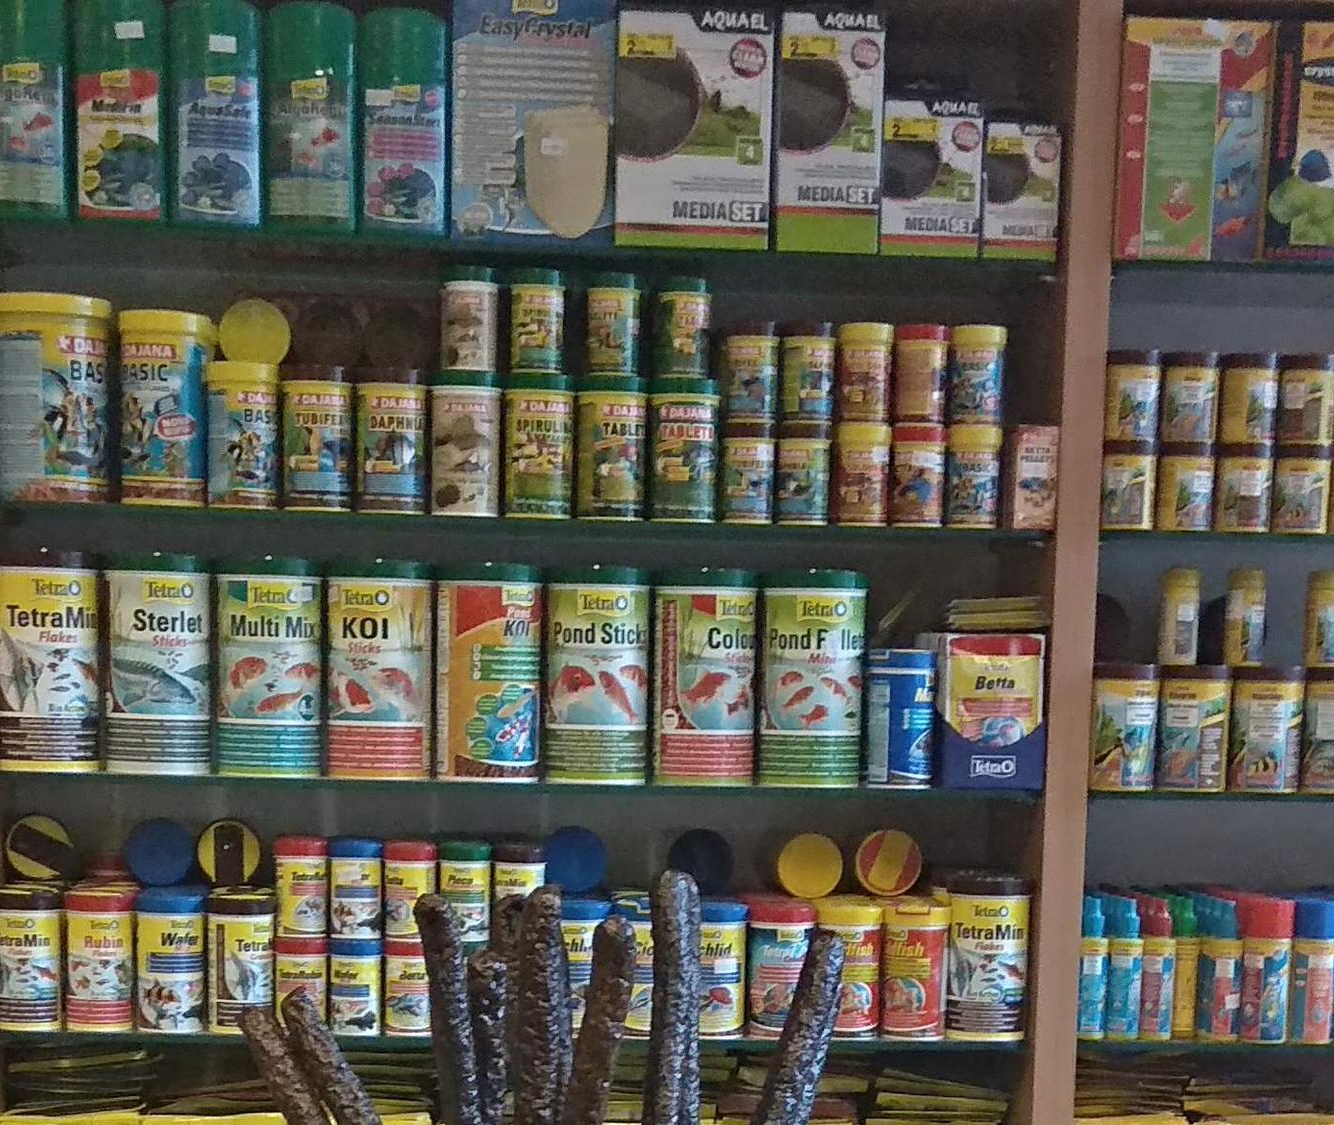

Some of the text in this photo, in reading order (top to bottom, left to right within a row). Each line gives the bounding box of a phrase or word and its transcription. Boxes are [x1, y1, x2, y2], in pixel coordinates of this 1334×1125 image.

[700, 12, 768, 30] AQUAEL
[824, 13, 880, 30] AQUAEL
[343, 589, 375, 605] Tetra
[579, 592, 613, 610] Tetra
[802, 599, 835, 617] Tetra
[133, 608, 203, 633] Sterlet
[230, 614, 317, 638] Multi Mix
[342, 617, 389, 640] KOI
[38, 632, 79, 644] Flakes
[151, 635, 188, 648] Sticks
[553, 622, 595, 645] Pond
[769, 629, 814, 650] Pond
[974, 675, 1016, 694] Betta
[955, 923, 1025, 940] TetraMin
[84, 935, 124, 949] Rubin
